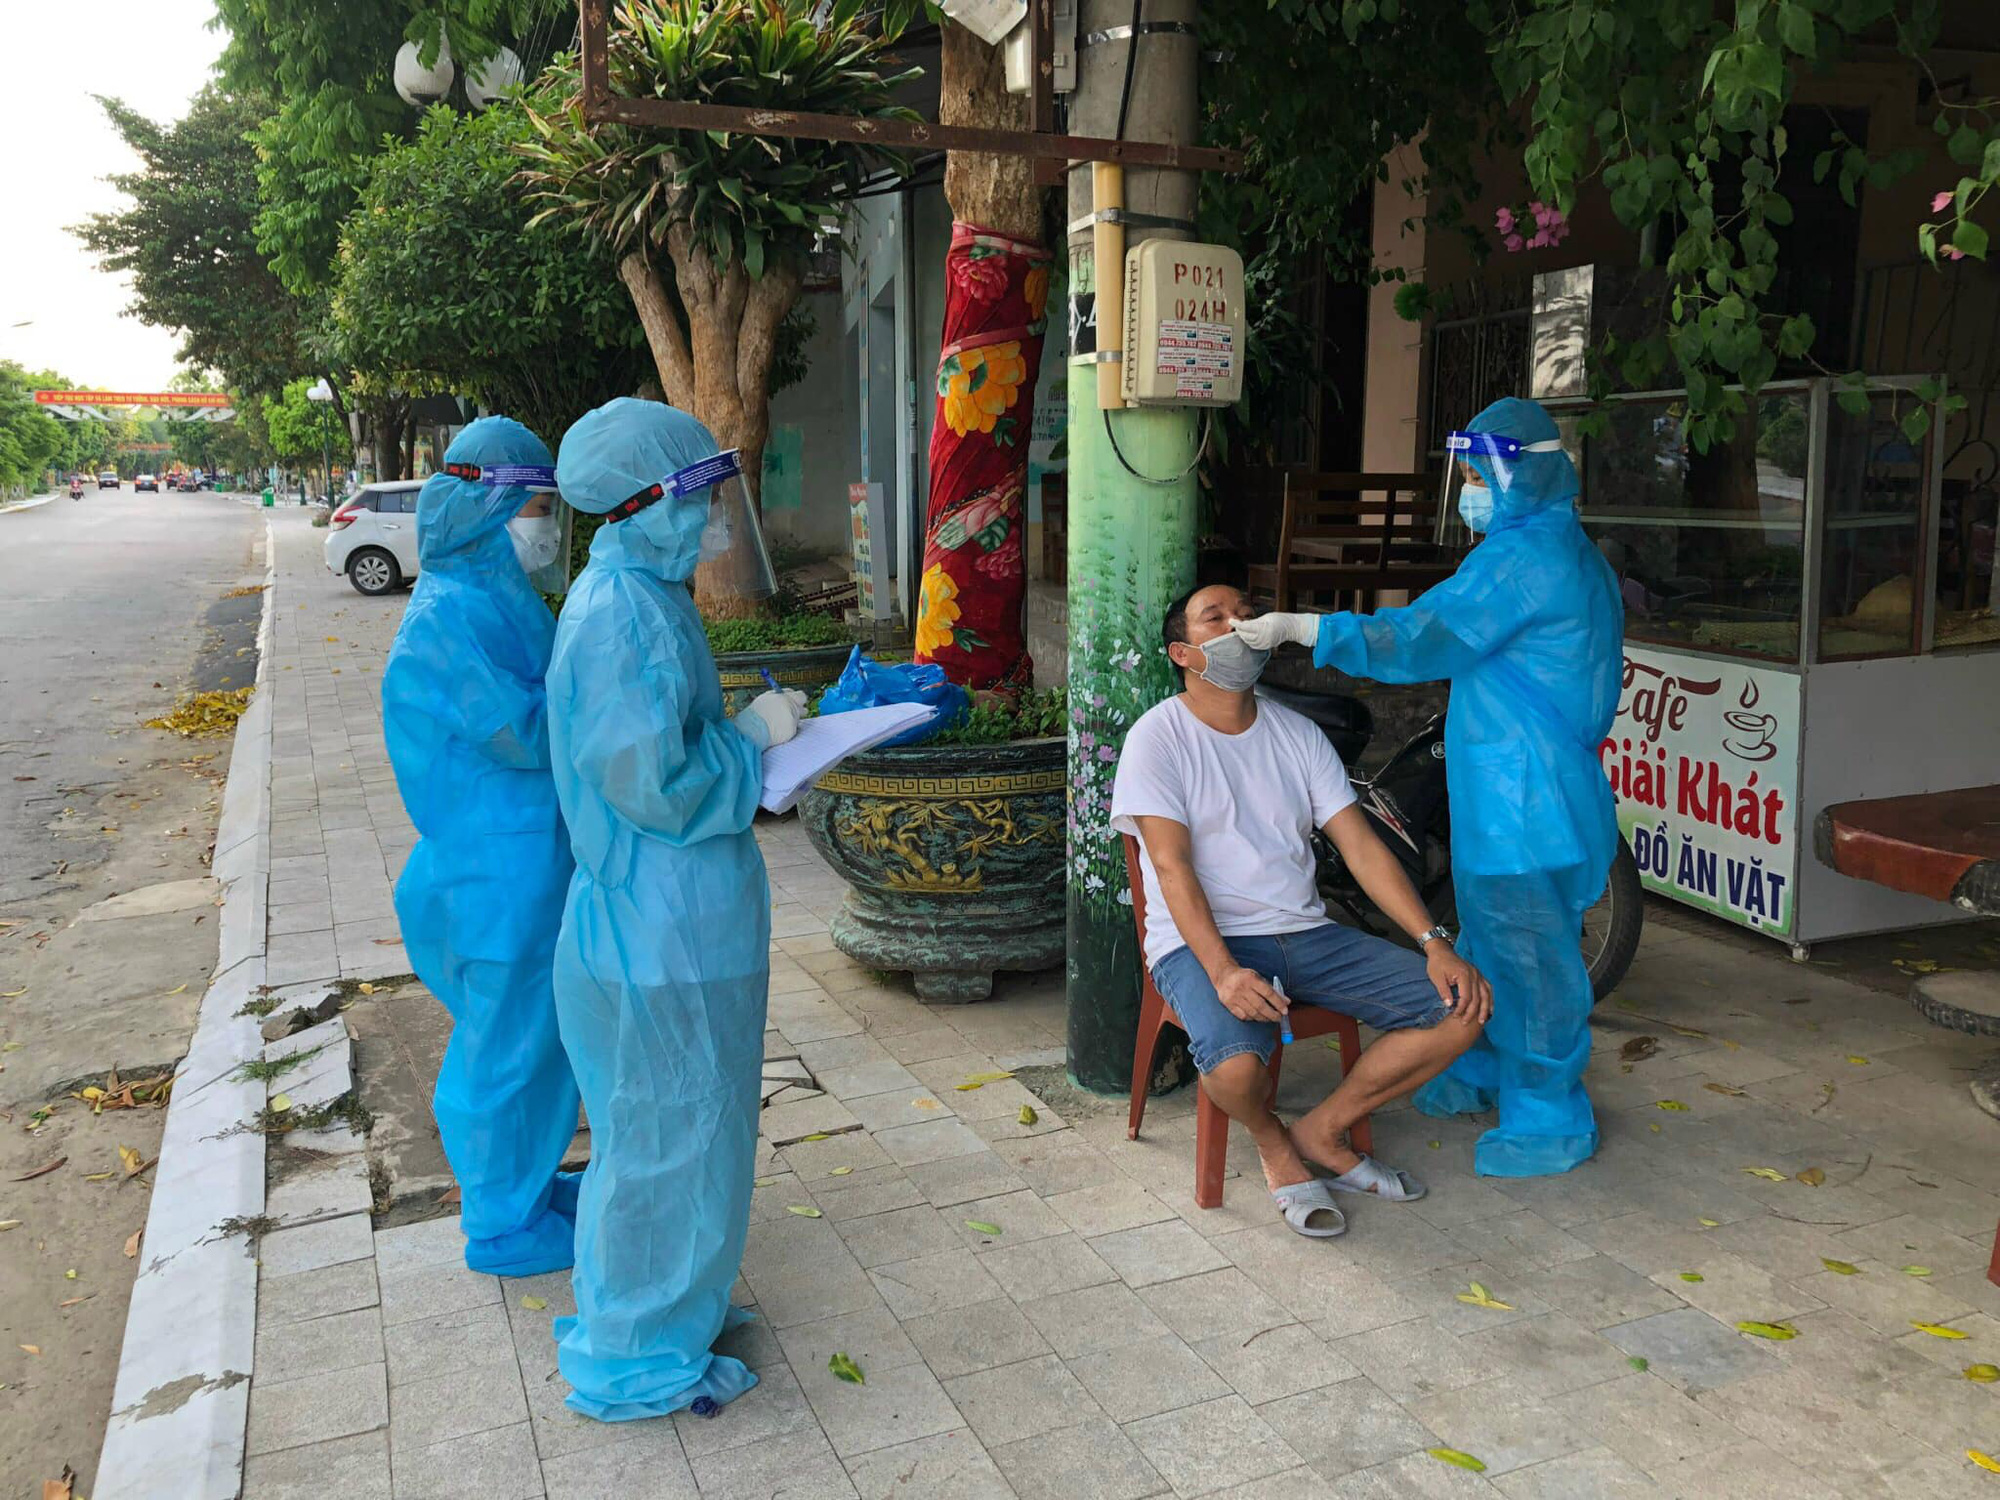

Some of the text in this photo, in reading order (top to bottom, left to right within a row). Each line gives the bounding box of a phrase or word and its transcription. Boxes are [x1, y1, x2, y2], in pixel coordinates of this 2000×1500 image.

[1174, 263, 1223, 289] P021
[1174, 298, 1226, 322] 024H
[1677, 756, 1783, 845] Khát
[1635, 820, 1785, 924] ĐỒ ĂN VẶT
